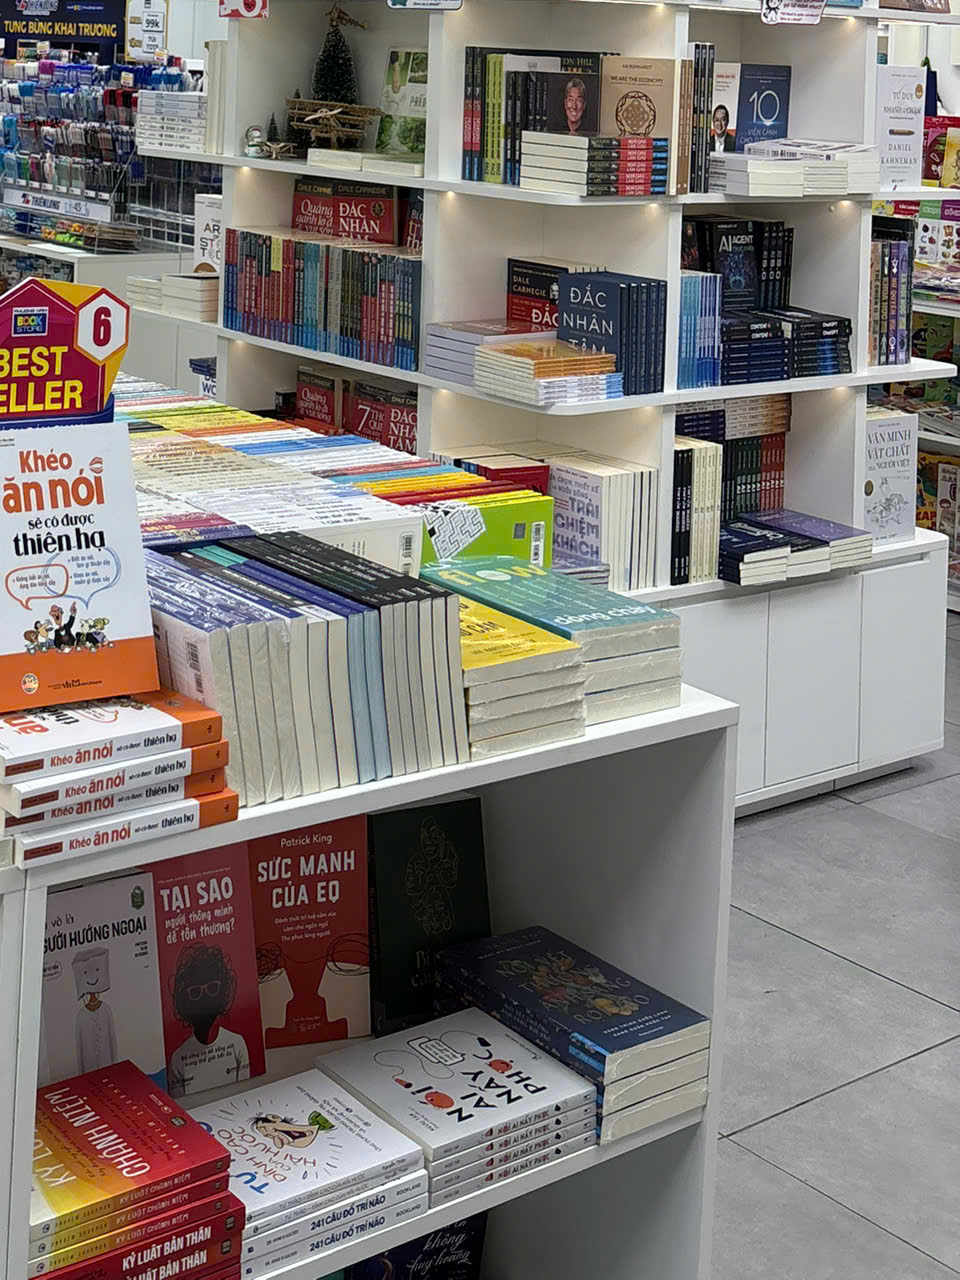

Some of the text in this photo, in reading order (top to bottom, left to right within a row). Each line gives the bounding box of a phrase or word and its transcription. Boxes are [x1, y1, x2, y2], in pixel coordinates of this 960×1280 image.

[54, 22, 77, 35] KHAI
[145, 18, 160, 29] 99k
[578, 58, 593, 66] HILL
[749, 90, 780, 124] 10
[888, 144, 911, 152] DANIEL
[880, 156, 918, 165] KAHNEMAN
[339, 217, 380, 234] NHÂN
[719, 234, 754, 253] AI AGENT
[513, 276, 530, 285] DALE
[513, 285, 547, 297] CARNEGIE
[569, 284, 607, 308] ĐẮC
[15, 324, 43, 333] STORE
[16, 315, 44, 327] BOOK
[92, 306, 112, 347] 6
[563, 311, 613, 336] NHÂN
[357, 404, 370, 432] 7
[868, 430, 911, 445] VĂN MINH
[18, 448, 73, 474] Khéo
[2, 462, 105, 513] ăn nói
[569, 497, 600, 518] TRẢI
[28, 513, 96, 530] sẽ có được
[13, 527, 106, 557] thiên hạ
[553, 534, 600, 560] KHÁCH
[553, 609, 610, 626] dòng
[50, 733, 165, 768] Khéo ăn nói thiên
[64, 761, 173, 799] Khéo ăn nói thiên
[51, 784, 166, 819] Khéo thiên
[69, 815, 181, 851] Khéo ăn nói thiên
[281, 833, 333, 848] Patrick King
[257, 850, 356, 884] SỨC MẠNH
[160, 876, 234, 913] TẠI SAO
[272, 880, 341, 909] CỦA EQ
[69, 917, 148, 947] HƯỚNG NGOẠI
[396, 1183, 421, 1195] BOOKLAND
[310, 1195, 386, 1231] 241 CÂU ĐỐ TRÍ NÃO
[396, 1204, 421, 1217] BOOKLAND
[310, 1216, 386, 1252] 241 CÂU ĐỐ TRÍ NÃO
[423, 1231, 468, 1251] không
[122, 1224, 212, 1272] KỶ LUẬT BẢN THÂN
[181, 1249, 207, 1272] THÂN
